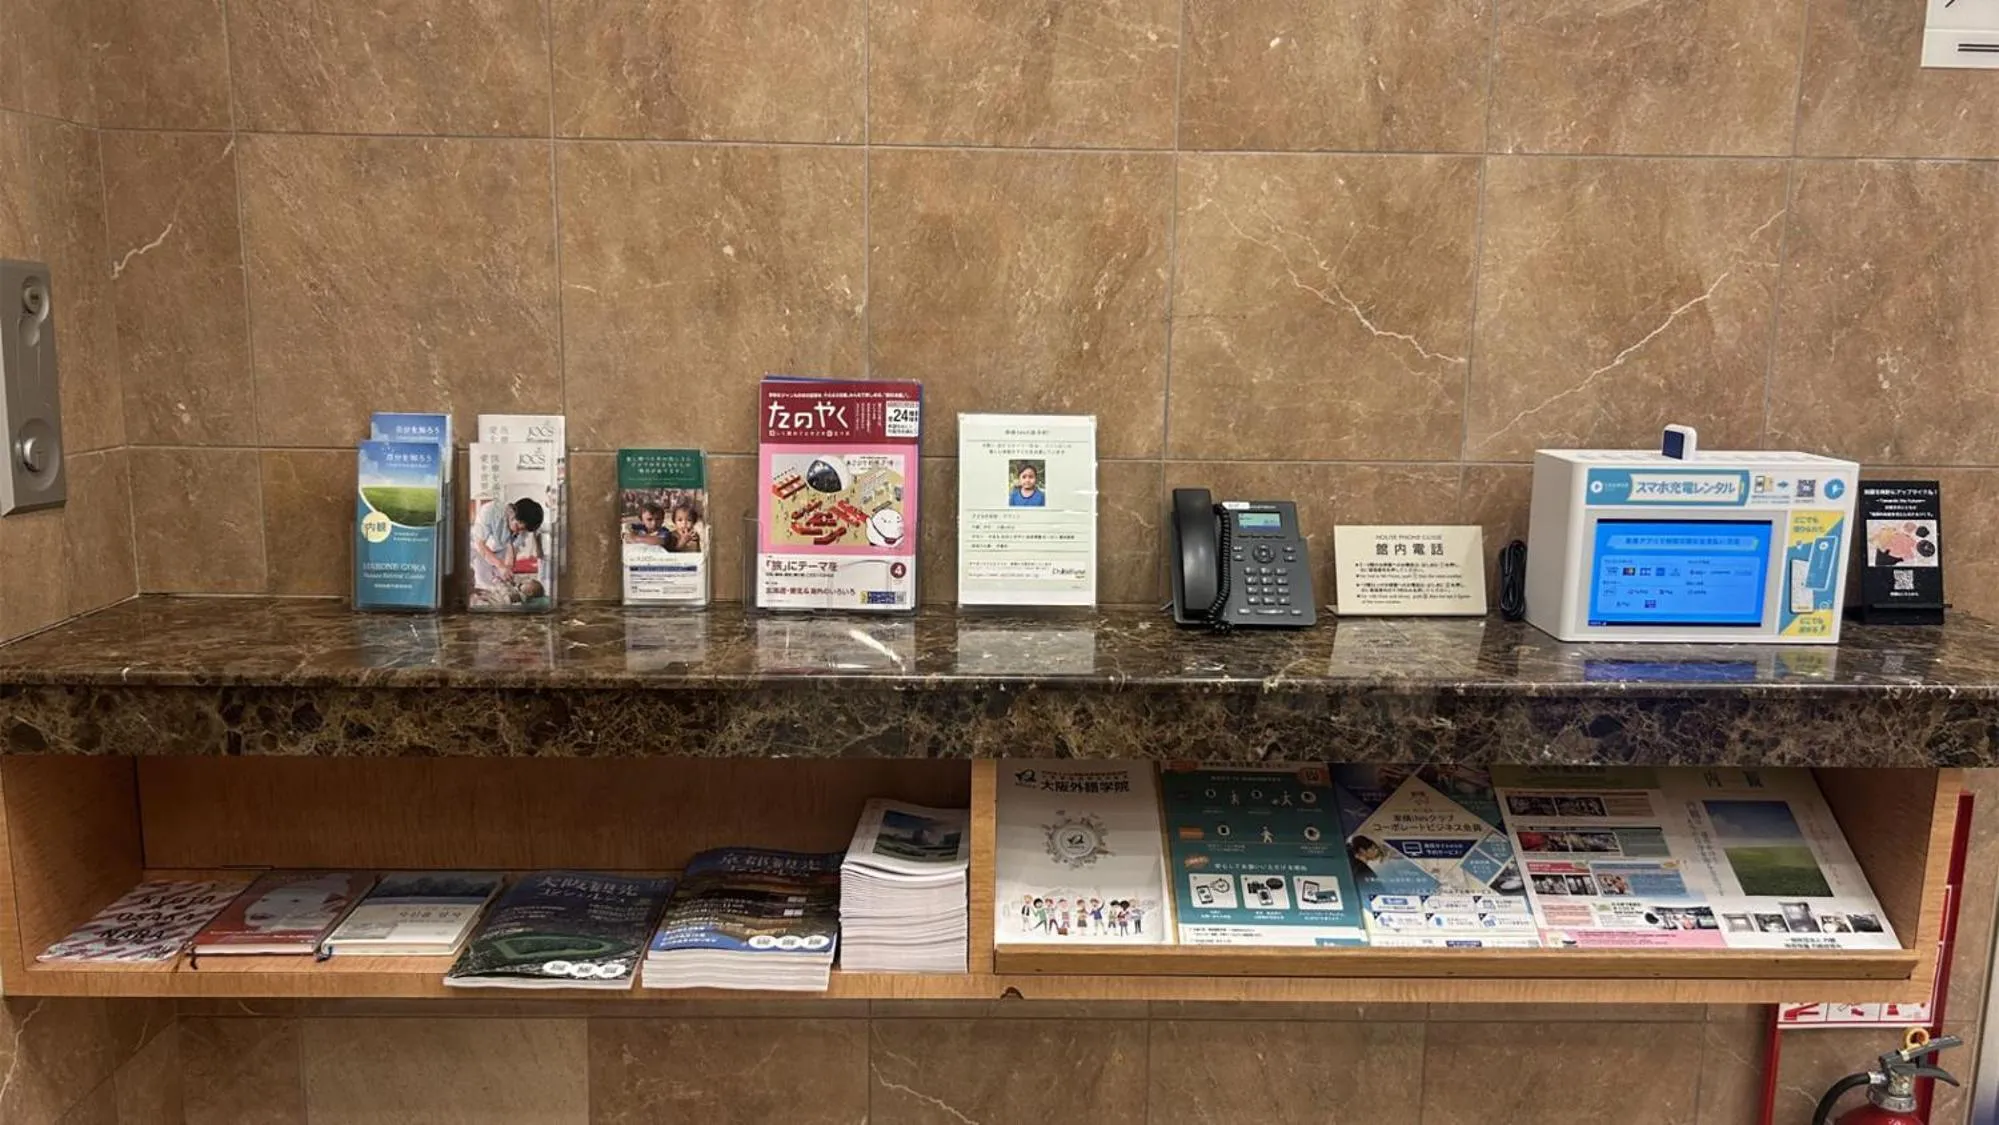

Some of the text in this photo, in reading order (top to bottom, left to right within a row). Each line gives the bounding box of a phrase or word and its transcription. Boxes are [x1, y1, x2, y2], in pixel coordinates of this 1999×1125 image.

[768, 400, 849, 429] たのやく
[893, 409, 909, 422] 24
[1635, 480, 1736, 495] スマホ充電レンタル
[1375, 543, 1444, 556] 館内電話
[1040, 779, 1131, 794] 大阪外語学院
